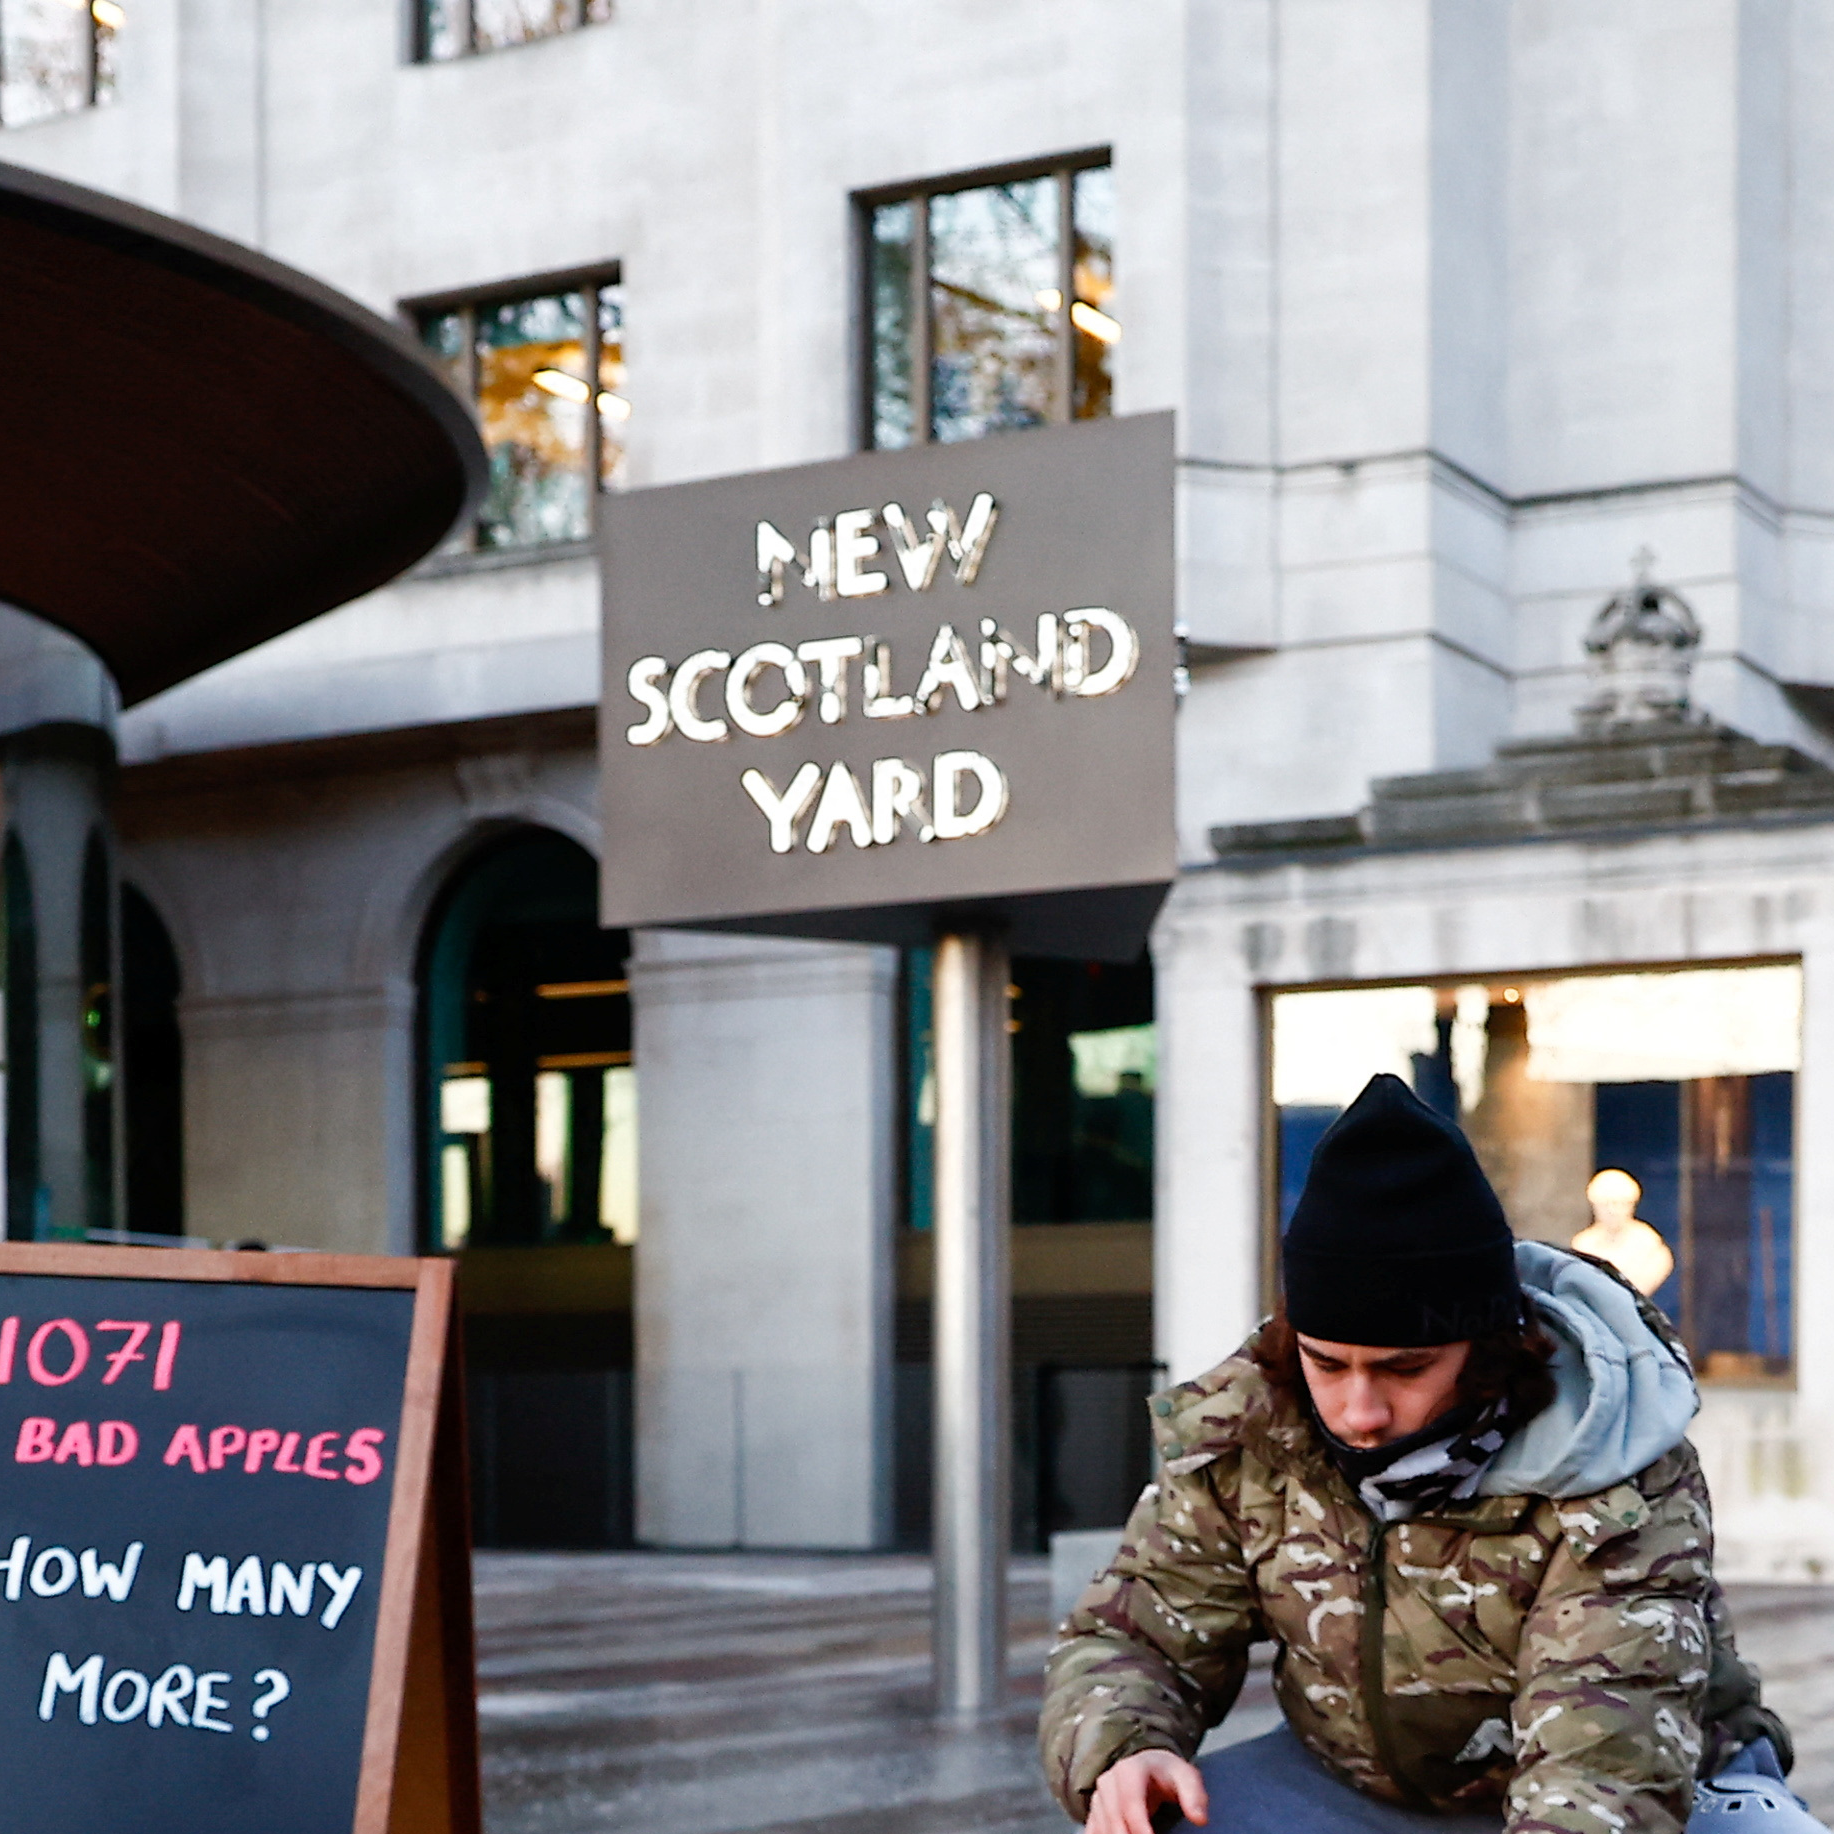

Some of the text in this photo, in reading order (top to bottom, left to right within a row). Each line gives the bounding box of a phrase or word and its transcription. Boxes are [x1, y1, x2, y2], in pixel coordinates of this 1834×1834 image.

[755, 491, 997, 607] NEW
[625, 605, 1140, 748] SCOTLAND
[739, 749, 1010, 855] YARD
[15, 1417, 387, 1485] BAD APPLES
[176, 1551, 363, 1630] MANY
